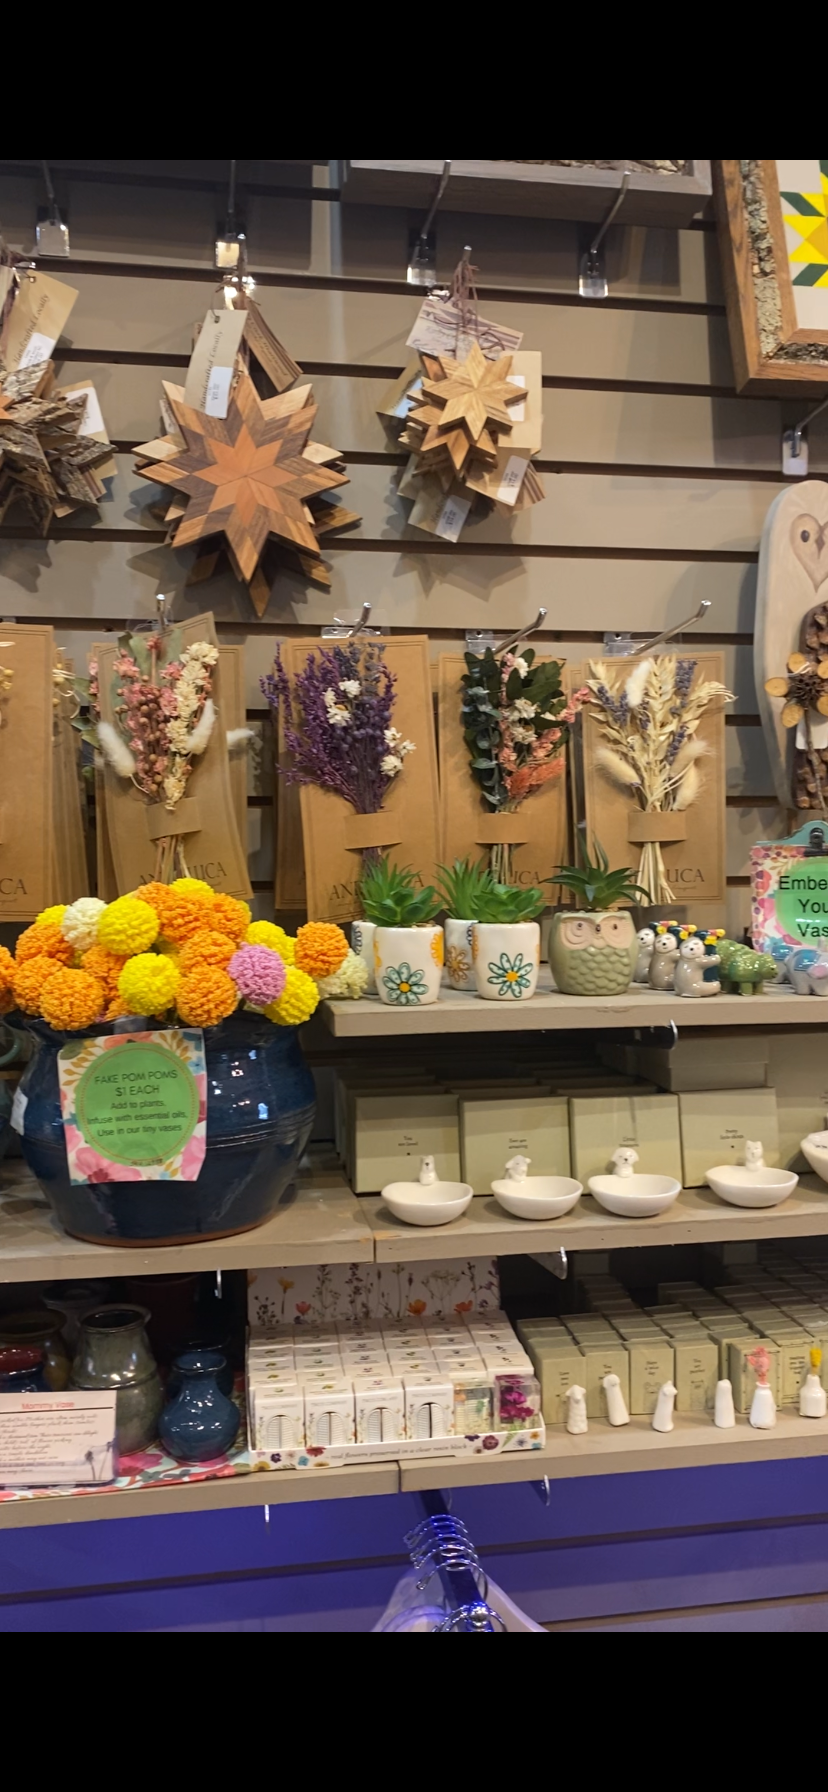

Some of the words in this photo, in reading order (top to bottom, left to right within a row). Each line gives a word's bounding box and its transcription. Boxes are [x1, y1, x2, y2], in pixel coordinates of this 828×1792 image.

[34, 294, 51, 322] Locally
[209, 331, 223, 358] Locally
[94, 1074, 119, 1085] FAKE
[121, 1072, 147, 1082] POM
[148, 1069, 178, 1080] POMS
[115, 1086, 126, 1097] $1
[129, 1084, 160, 1096] EACH
[110, 1102, 128, 1110] Add
[128, 1101, 138, 1109] to
[87, 1116, 113, 1125] Infuse
[114, 1114, 132, 1122] with
[133, 1111, 170, 1121] essential
[97, 1129, 115, 1137] Use
[116, 1127, 125, 1135] in
[141, 1125, 157, 1134] tiny
[157, 1124, 182, 1132] vases
